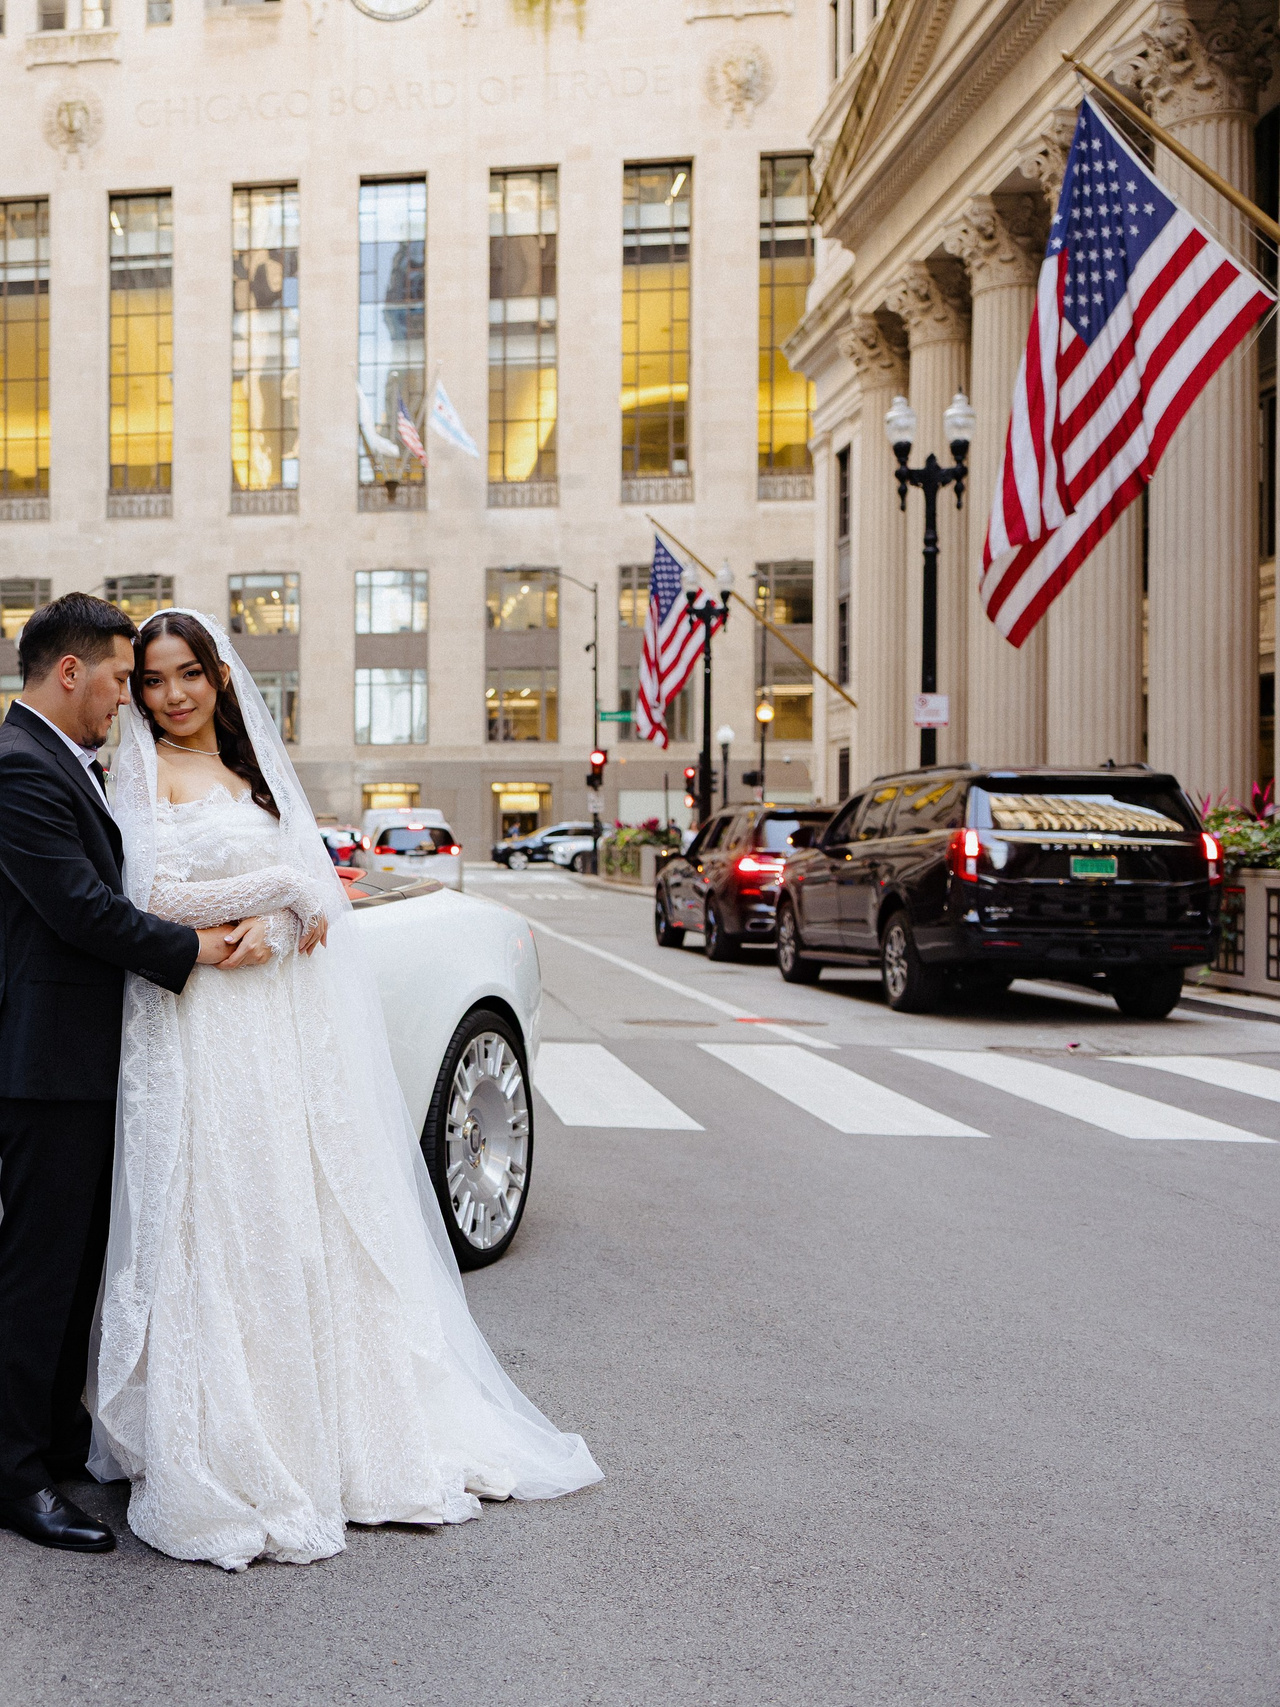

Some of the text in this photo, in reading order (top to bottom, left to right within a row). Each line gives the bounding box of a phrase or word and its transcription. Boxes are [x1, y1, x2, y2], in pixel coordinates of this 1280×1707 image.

[134, 64, 671, 129] CHICAGO BOARD OF TRADE
